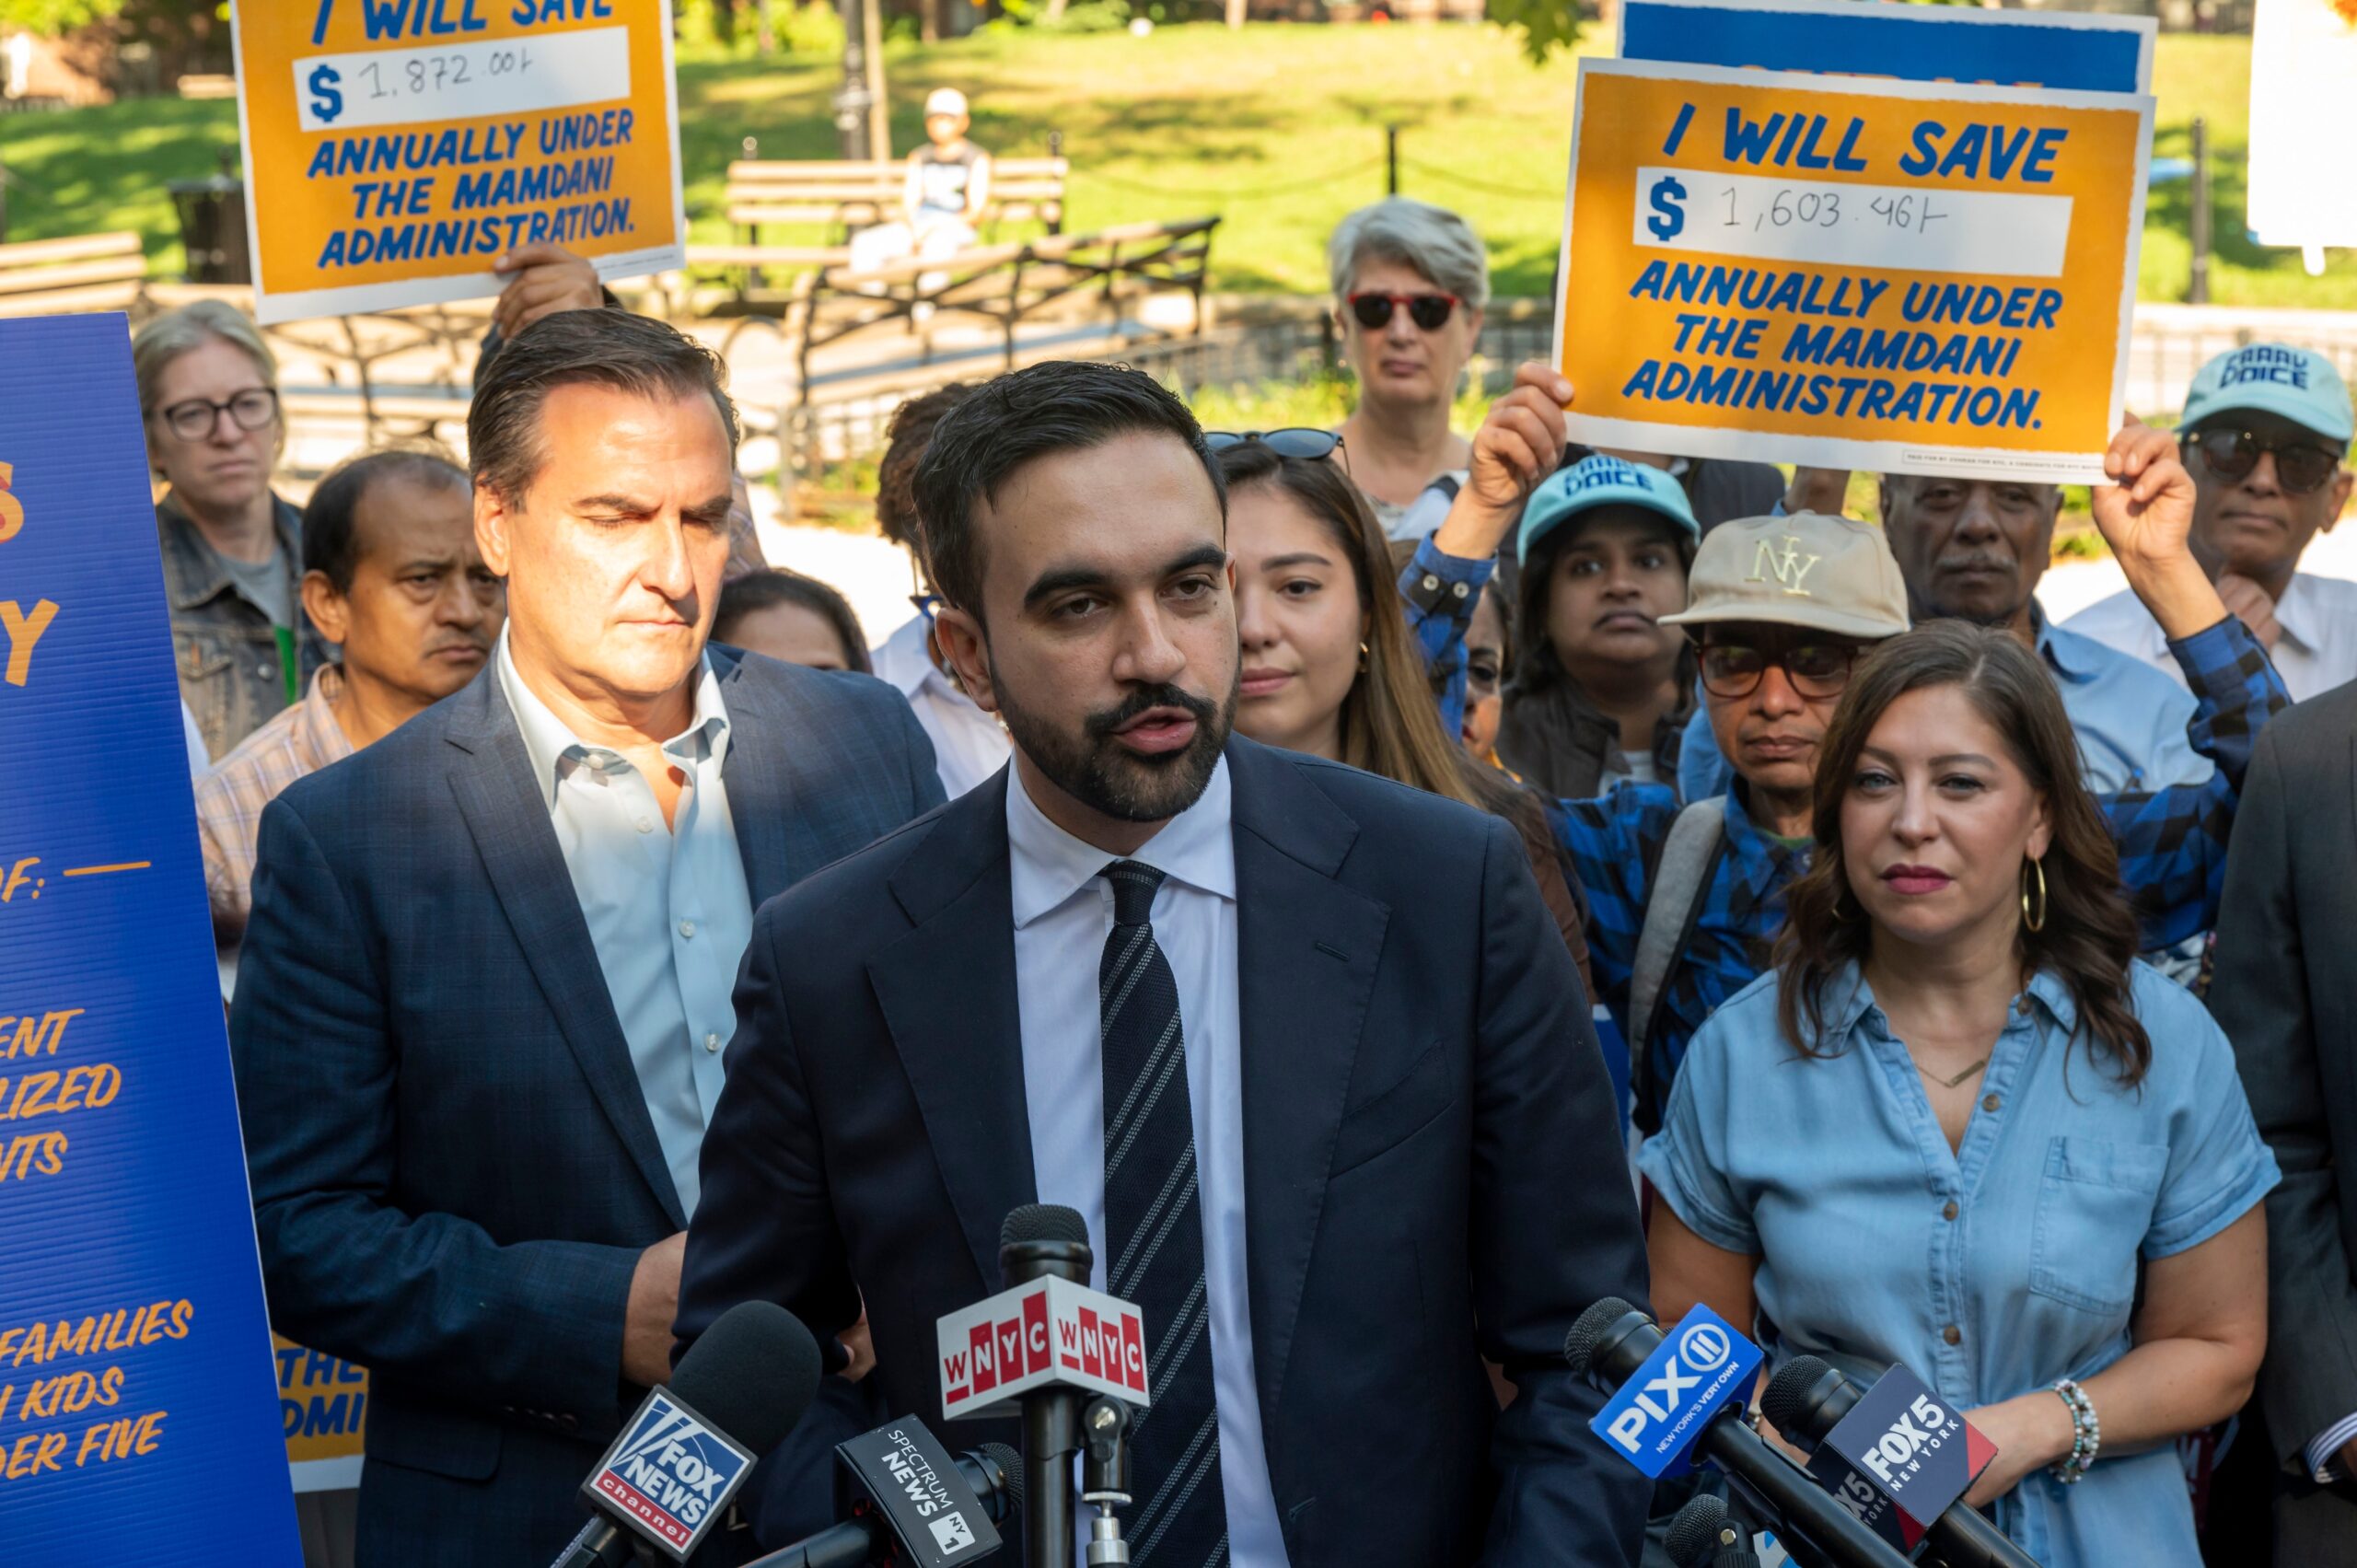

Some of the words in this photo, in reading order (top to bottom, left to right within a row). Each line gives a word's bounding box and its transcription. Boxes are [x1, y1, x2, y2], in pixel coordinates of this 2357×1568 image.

[311, 0, 332, 45] I
[364, 0, 487, 40] WILL
[308, 64, 343, 122] $
[307, 123, 526, 179] ANNUALLY
[540, 109, 634, 156] UNDER
[1662, 102, 1696, 157] I
[1723, 107, 1868, 172] WILL
[1898, 121, 2069, 183] SAVE
[352, 177, 435, 219] THE
[451, 156, 615, 211] MAMDANI
[1647, 176, 1687, 241] $
[318, 198, 634, 269] ADMINISTRATION.
[1629, 260, 1889, 319] ANNUALLY
[1900, 281, 2063, 330] UNDER
[1673, 314, 1769, 359] THE
[1781, 323, 2022, 378] MAMDANI
[1622, 360, 2042, 430] ADMINISTRATION.
[1743, 535, 1821, 598] NY
[0, 857, 45, 903] F:
[0, 1299, 193, 1367] FAMILIES
[944, 1321, 1046, 1384] WNYC
[1059, 1318, 1141, 1372] WNYC
[19, 1366, 124, 1421] KIDS
[1607, 1354, 1703, 1455] PIX
[1655, 1433, 1677, 1454] NEW
[1671, 1401, 1702, 1436] YORK'S
[1698, 1382, 1722, 1405] VERY
[1718, 1361, 1740, 1384] OWN
[0, 1434, 66, 1480] ER
[75, 1411, 168, 1467] FIVE
[656, 1438, 726, 1501] FOX
[888, 1429, 954, 1508] SPECTRUM
[1890, 1459, 1921, 1492] NEW
[1922, 1419, 1959, 1458] YORK
[602, 1479, 687, 1542] channel
[623, 1453, 706, 1524] NEWS
[881, 1451, 938, 1516] NEWS
[944, 1537, 959, 1550] 1
[949, 1516, 966, 1534] NY
